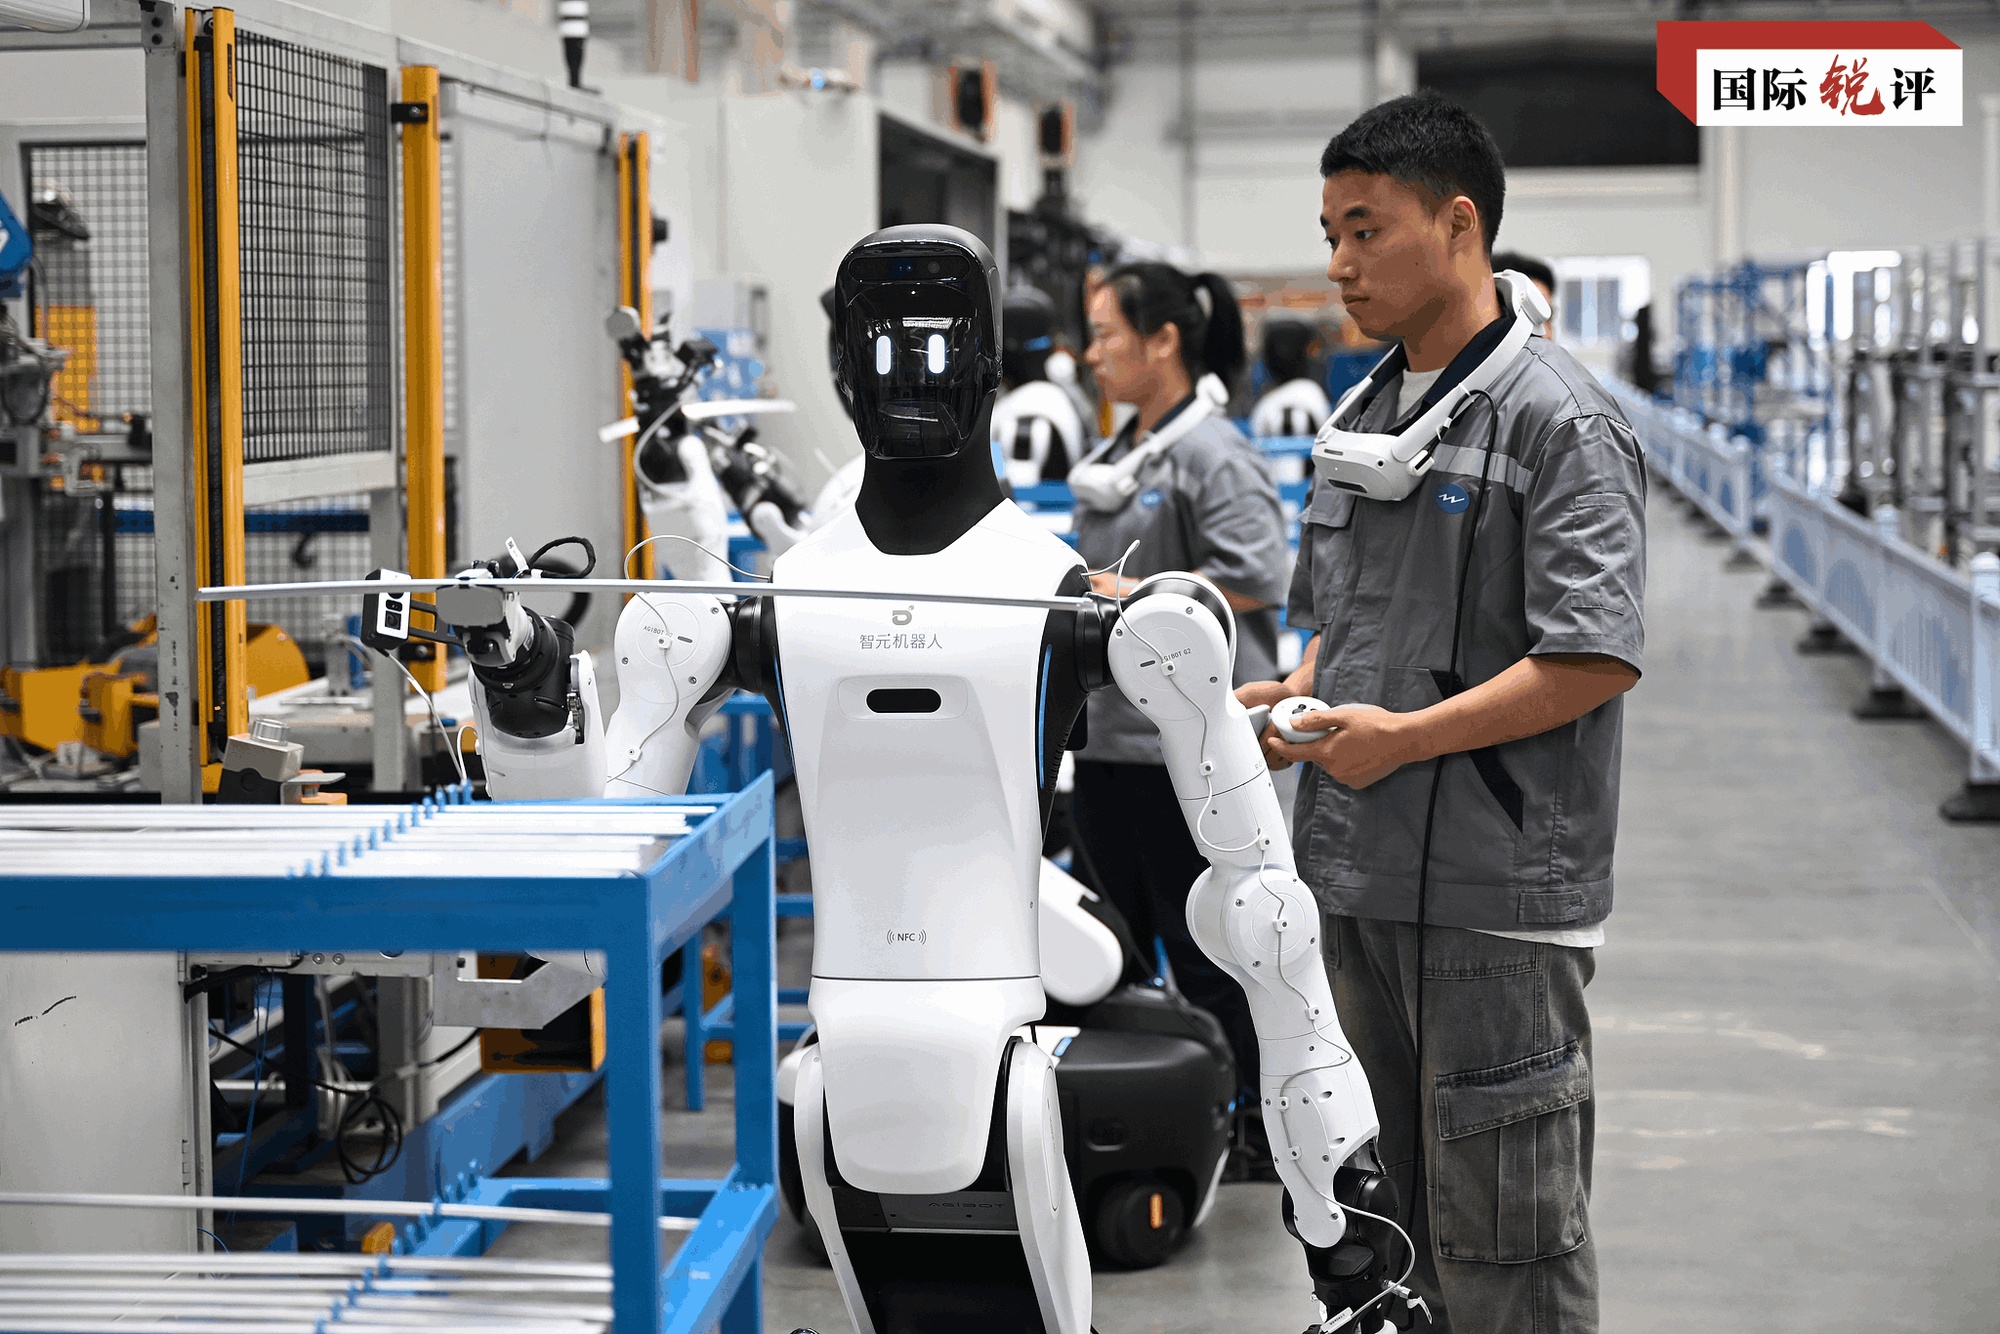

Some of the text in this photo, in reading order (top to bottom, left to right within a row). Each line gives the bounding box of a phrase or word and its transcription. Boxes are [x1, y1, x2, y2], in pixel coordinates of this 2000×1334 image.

[859, 633, 943, 650] 智元机器人
[1163, 650, 1182, 661] GIBOT
[897, 933, 916, 942] NFC
